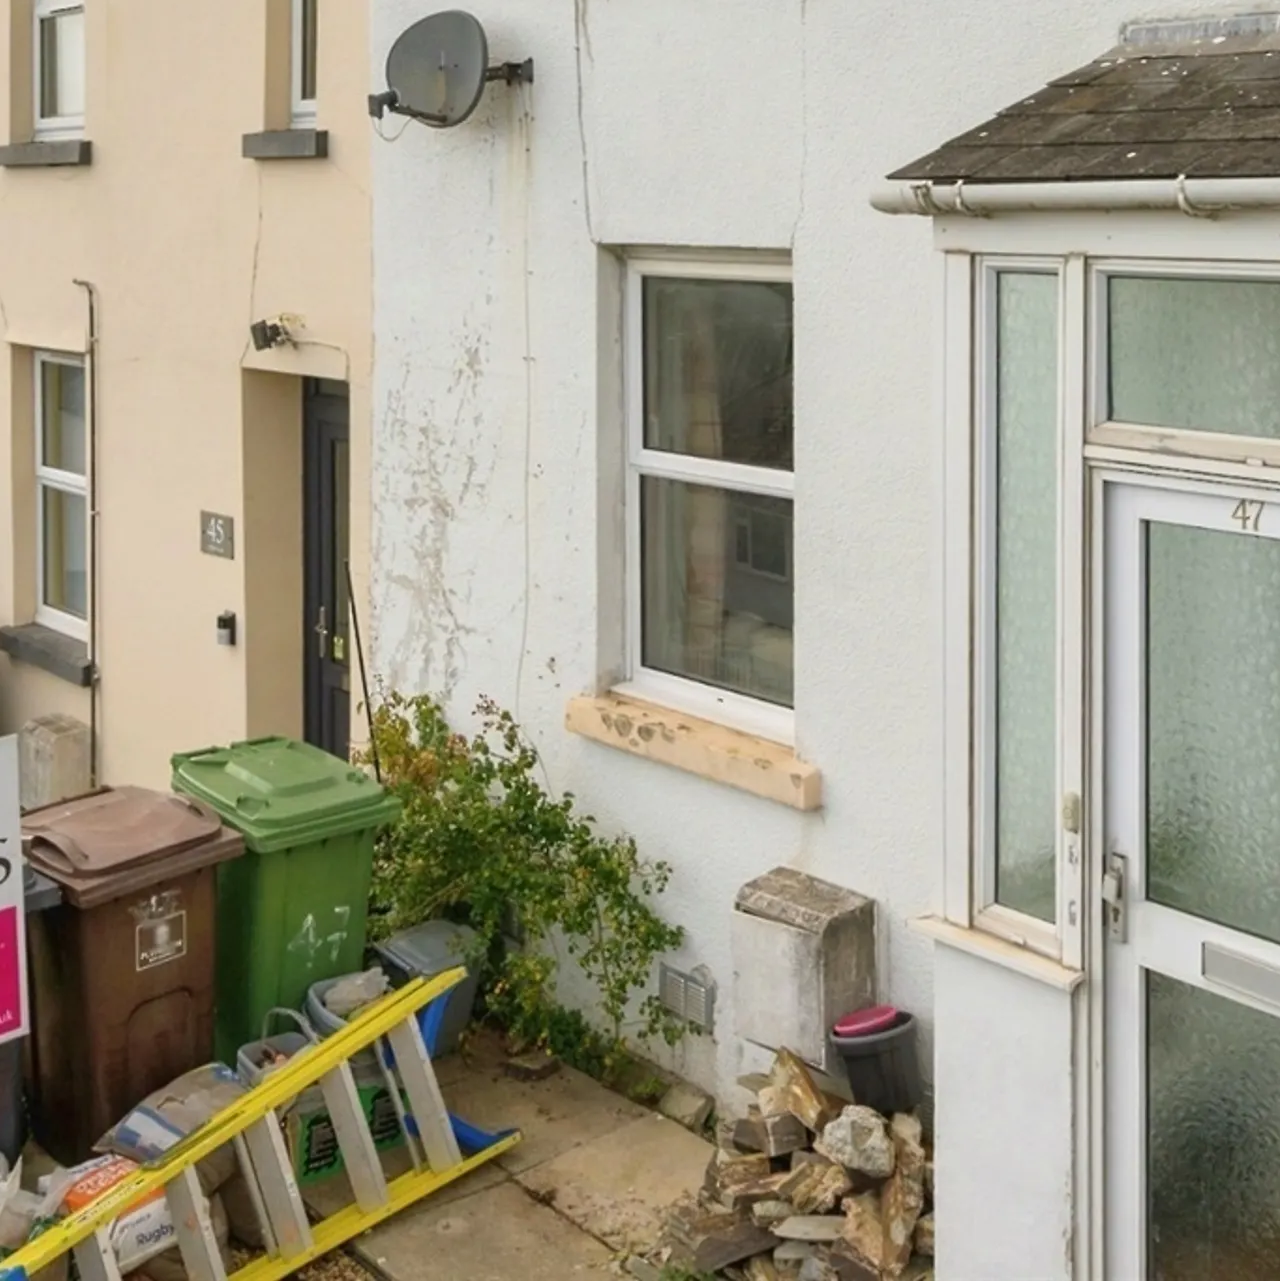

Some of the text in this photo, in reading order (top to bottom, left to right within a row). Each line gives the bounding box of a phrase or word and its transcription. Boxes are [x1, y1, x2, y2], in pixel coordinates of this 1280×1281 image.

[1231, 498, 1266, 531] 47
[206, 517, 225, 544] 45
[286, 905, 350, 968] 47
[135, 1222, 174, 1246] Rugby
